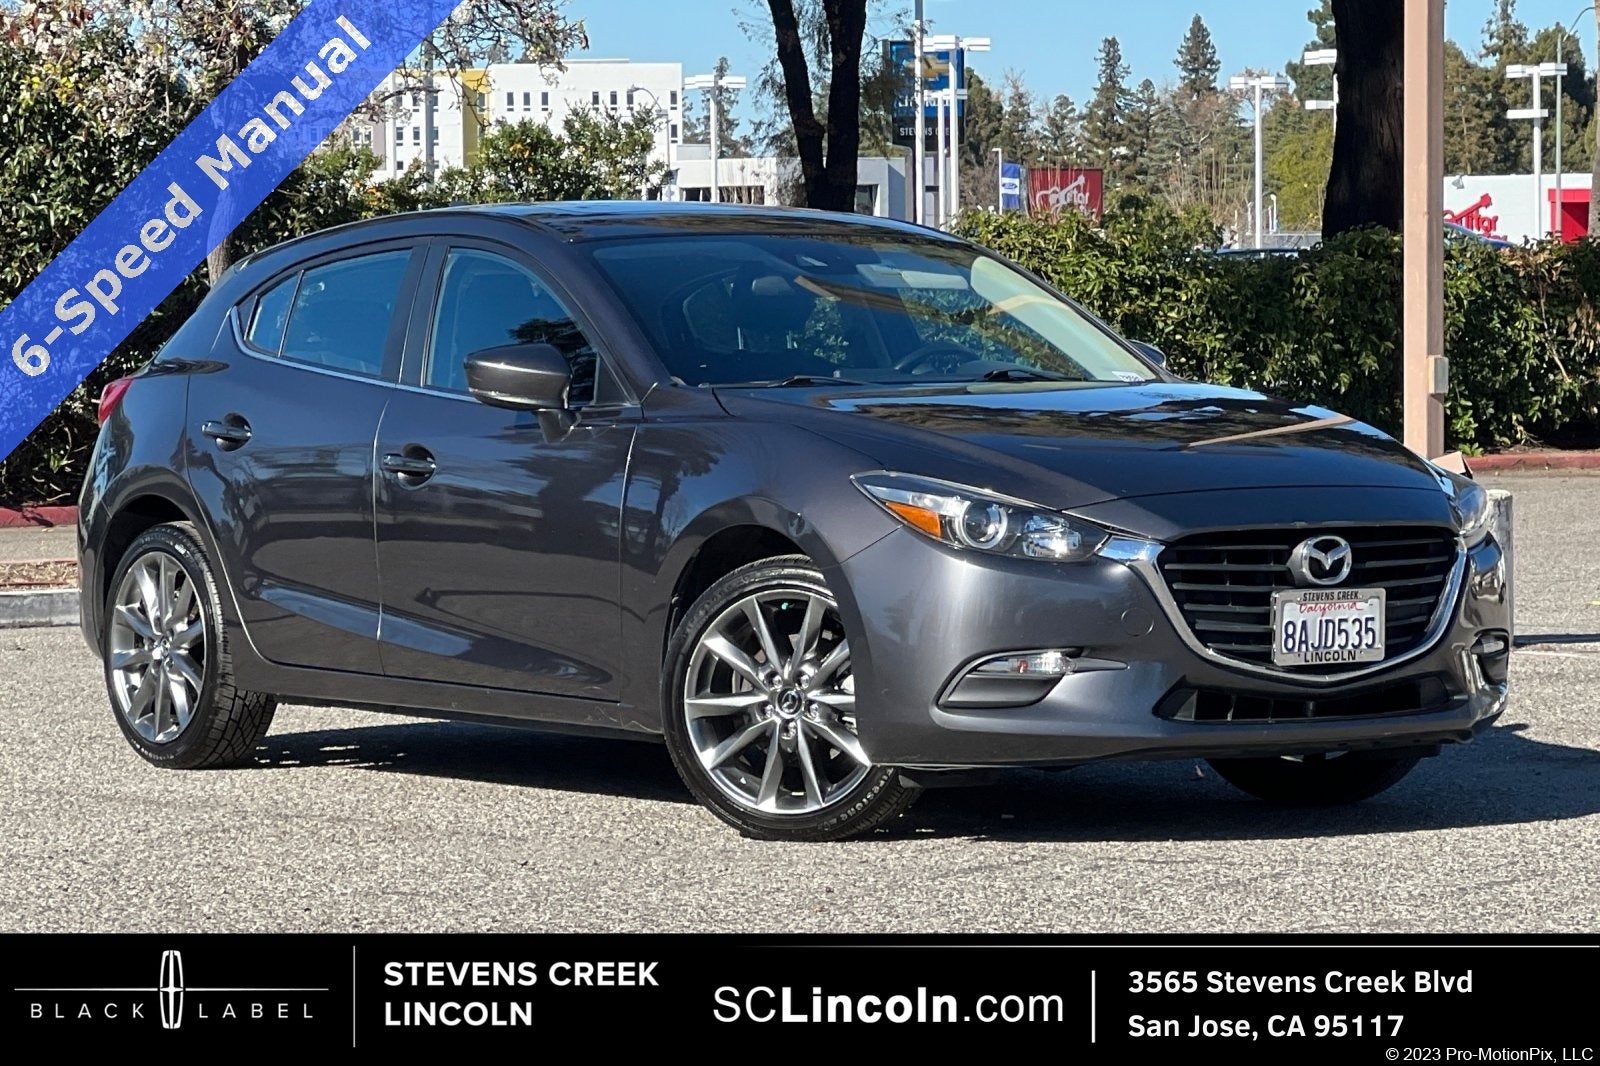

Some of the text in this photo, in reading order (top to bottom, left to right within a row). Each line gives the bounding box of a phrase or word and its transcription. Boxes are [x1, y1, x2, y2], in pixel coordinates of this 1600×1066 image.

[900, 127, 933, 136] STENS
[1303, 590, 1360, 602] STEVENS CREEK
[1299, 601, 1364, 617] California
[1283, 616, 1376, 653] 8AJD535
[1304, 650, 1357, 663] LINCOLN
